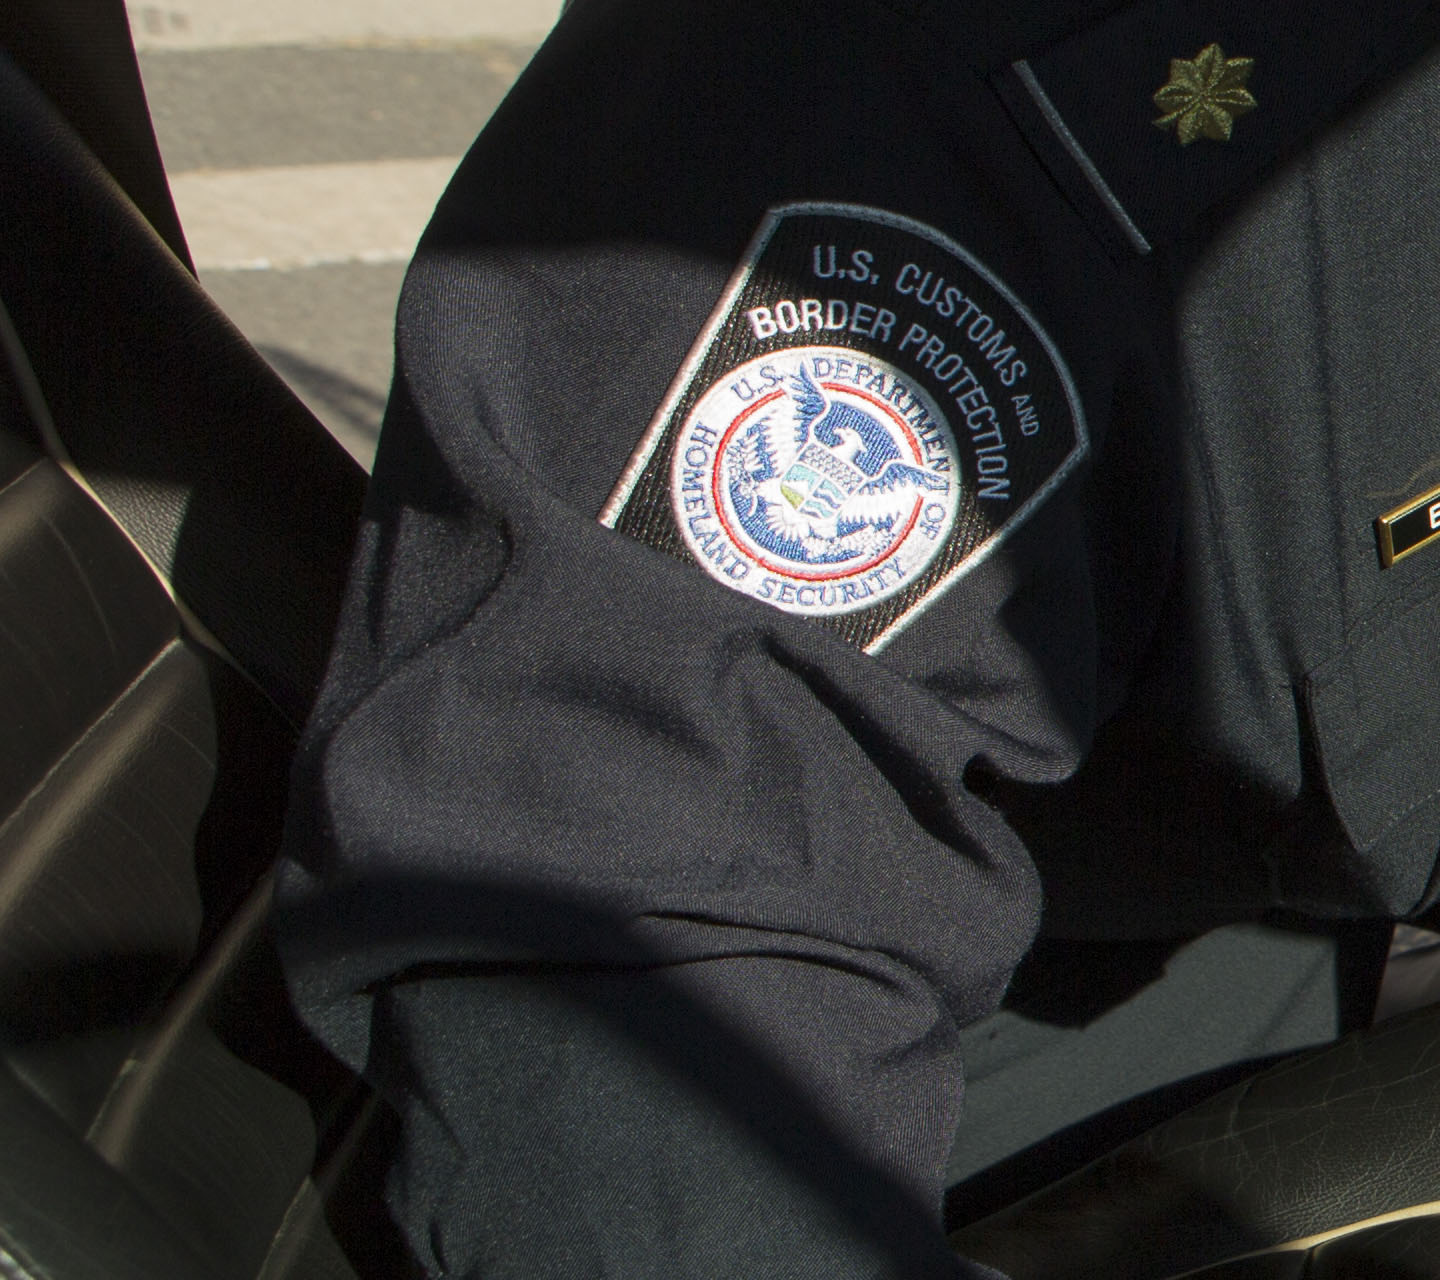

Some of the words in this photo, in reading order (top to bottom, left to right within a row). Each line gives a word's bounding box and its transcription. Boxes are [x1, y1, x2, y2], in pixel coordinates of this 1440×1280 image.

[730, 364, 783, 402] U.S.
[745, 298, 895, 342] BORDER
[898, 322, 1011, 502] PROTECTION
[812, 244, 878, 283] U.S.
[894, 262, 1028, 387] CUSTOMS
[1009, 393, 1041, 439] AND
[811, 356, 950, 498] DEPARTMENT
[678, 419, 749, 582] HOMELAND
[922, 500, 950, 541] OF
[755, 556, 908, 608] SECURITY
